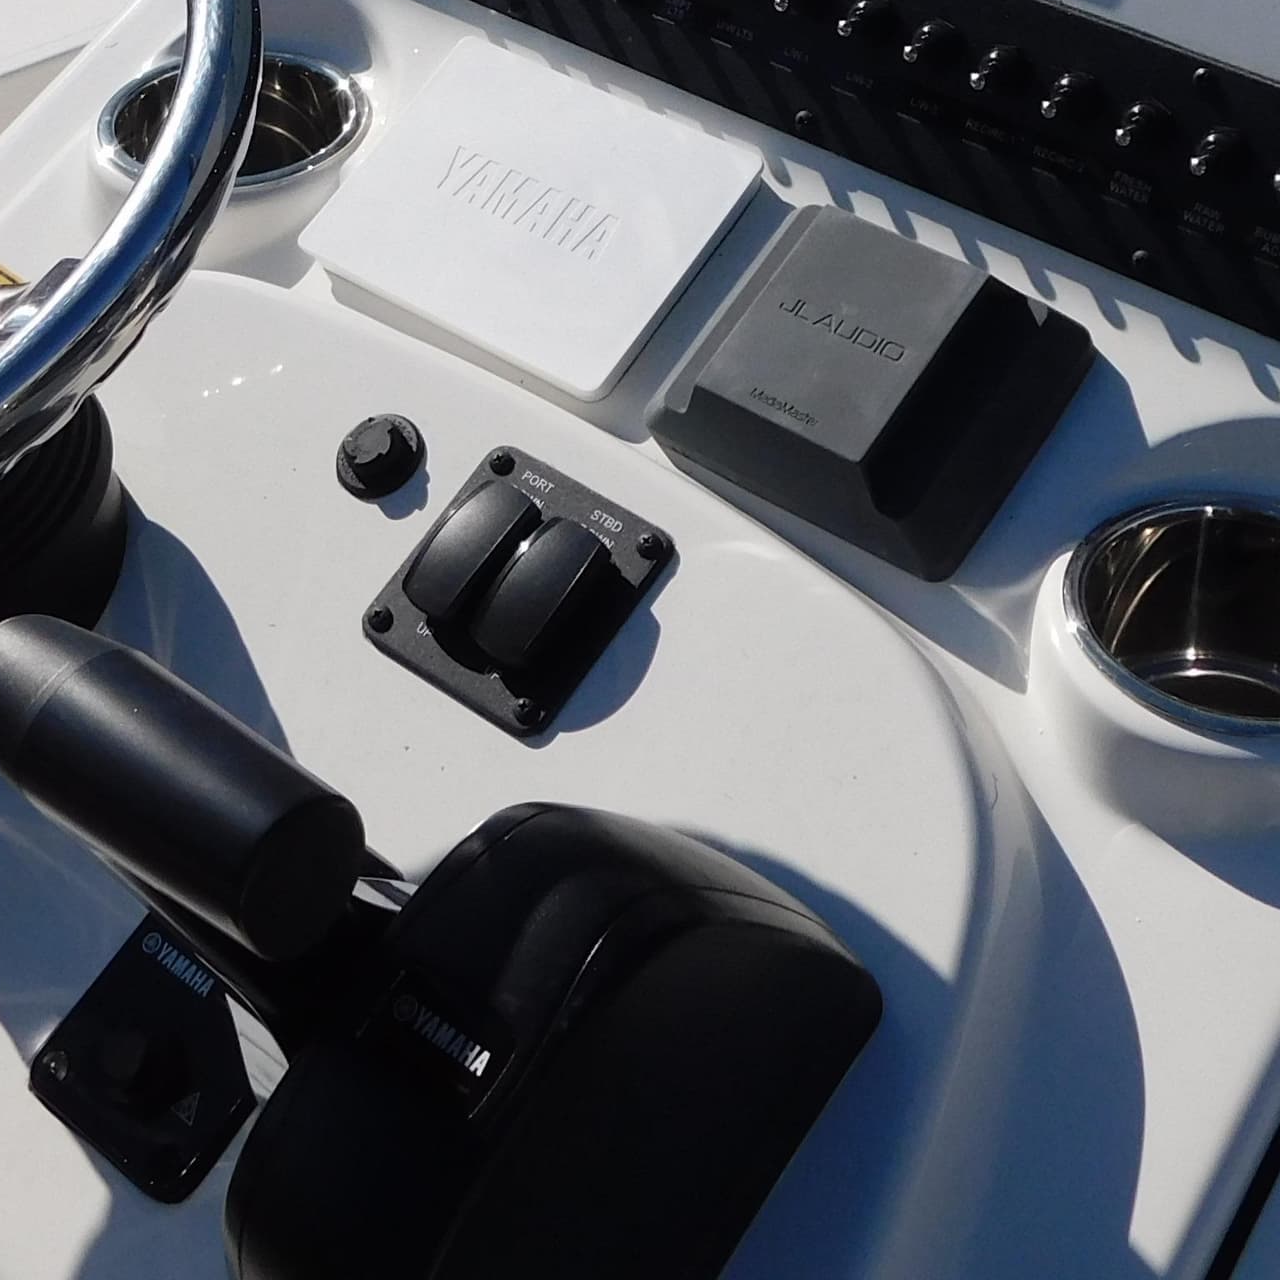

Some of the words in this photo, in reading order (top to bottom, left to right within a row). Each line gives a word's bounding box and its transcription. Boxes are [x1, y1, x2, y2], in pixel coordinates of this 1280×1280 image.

[437, 145, 618, 263] YAMAHA
[1181, 210, 1225, 235] WATER
[779, 299, 809, 321] JL
[812, 313, 906, 362] AUDIO
[750, 387, 819, 426] MediaMaster
[521, 470, 555, 494] PORT
[590, 509, 623, 533] STBD
[156, 942, 215, 998] YAMAHA
[414, 1006, 491, 1077] YAMAHA
